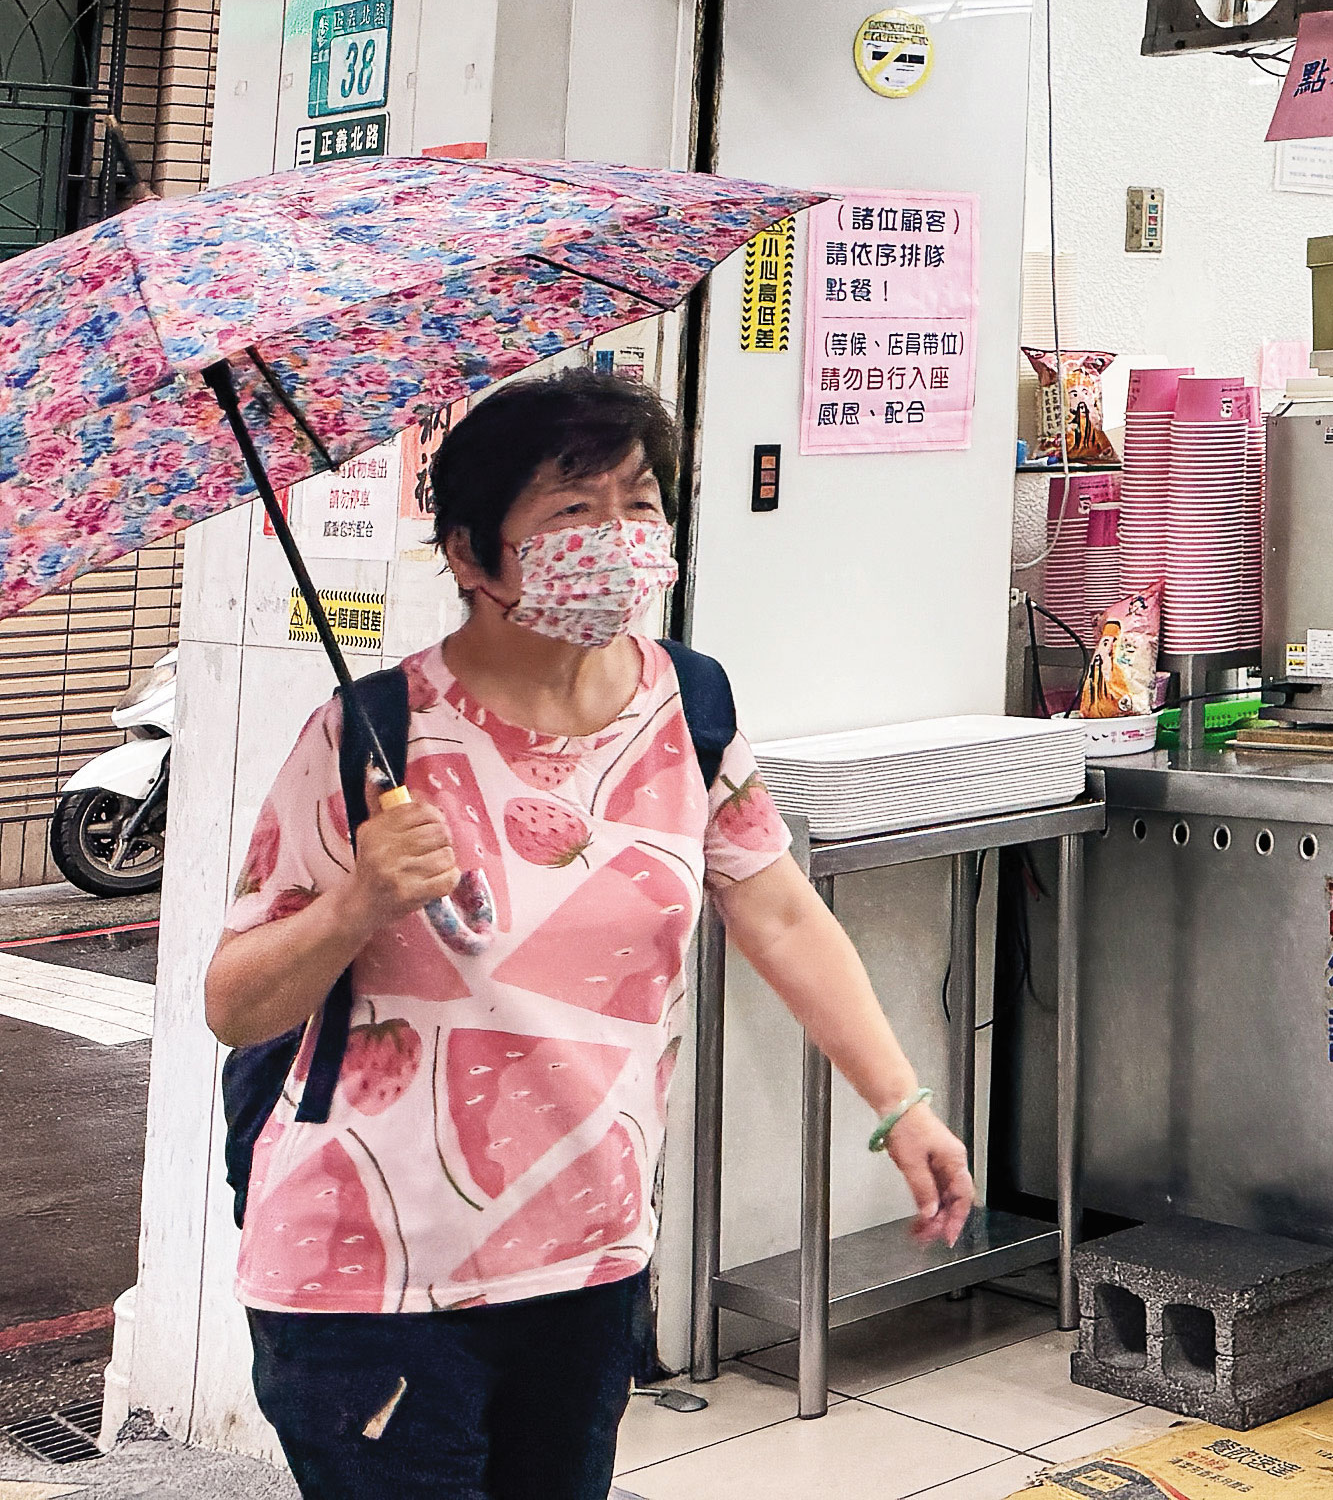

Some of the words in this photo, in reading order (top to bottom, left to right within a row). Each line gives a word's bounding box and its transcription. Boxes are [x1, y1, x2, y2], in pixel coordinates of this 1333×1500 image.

[340, 39, 375, 98] 38
[320, 123, 380, 156] 正義北路
[837, 204, 960, 234] (諸位顧客)
[826, 241, 945, 268] 請依序排隊
[756, 238, 779, 349] 小心高低差
[821, 366, 950, 391] 請勿自行入座
[818, 400, 926, 426] 感恩、配合
